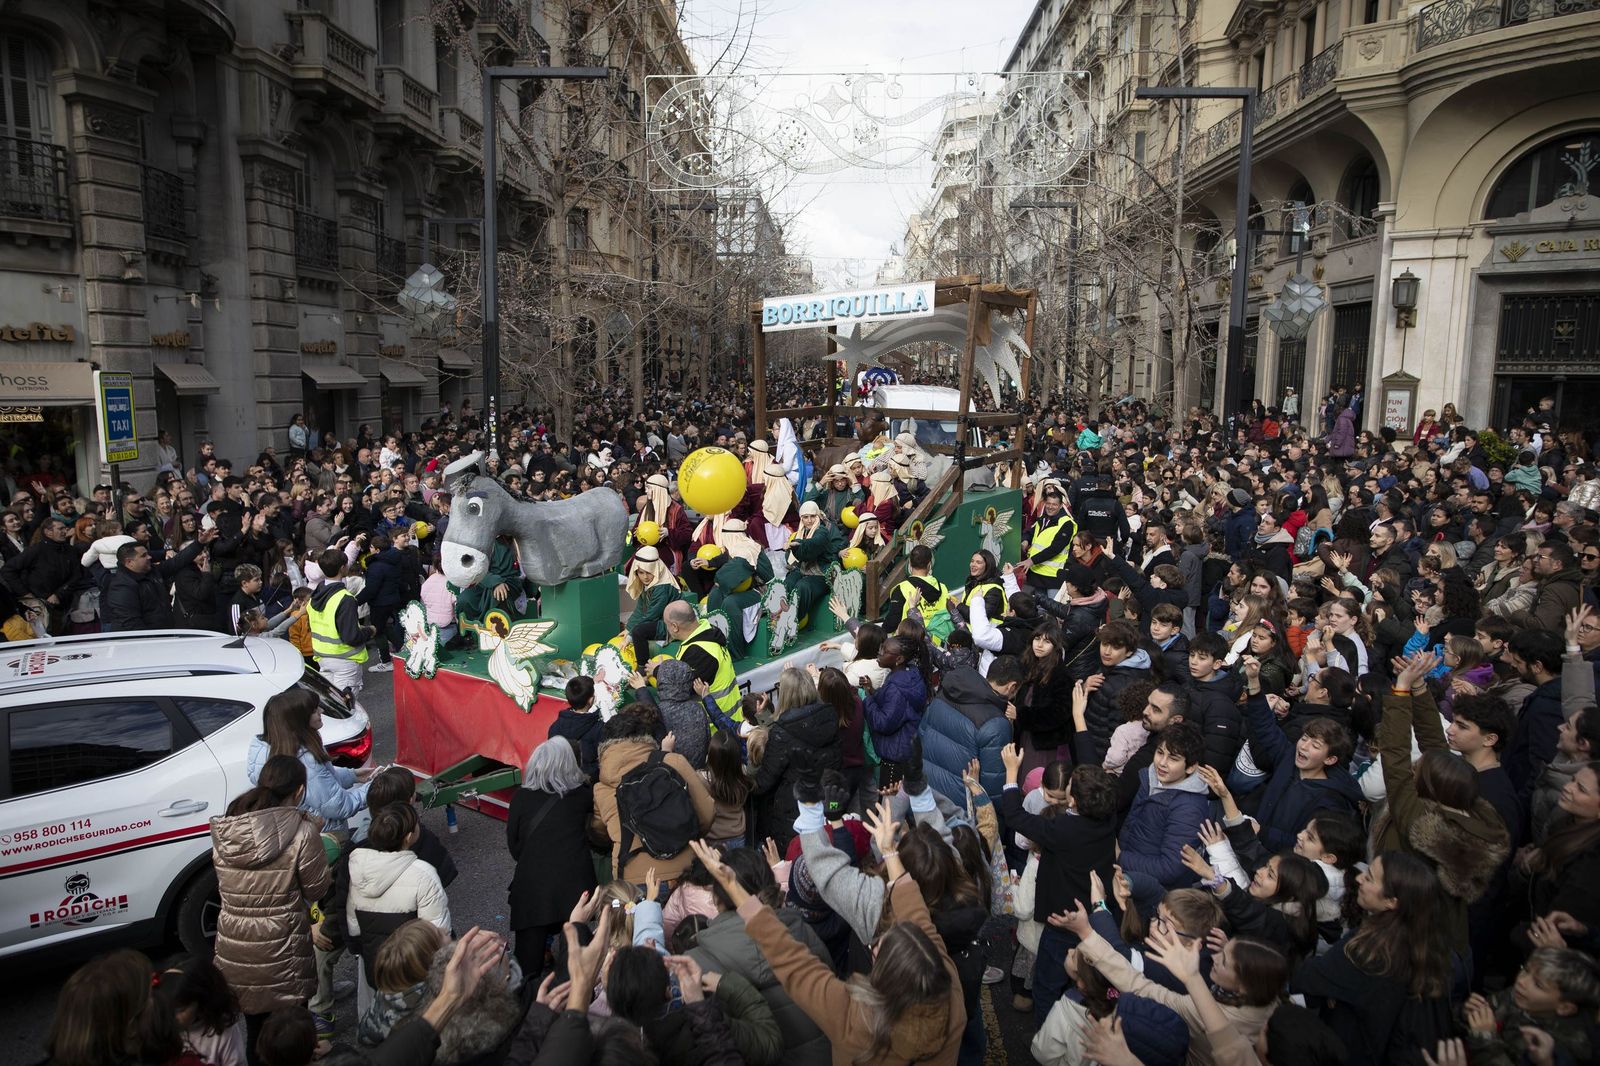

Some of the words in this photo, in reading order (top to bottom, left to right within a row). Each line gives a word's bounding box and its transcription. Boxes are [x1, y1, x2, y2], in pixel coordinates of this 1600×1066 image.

[1536, 239, 1578, 253] CAJA
[763, 289, 928, 326] BORRIQUILLA
[0, 322, 75, 343] tefiel
[0, 373, 49, 386] hoss
[112, 419, 130, 432] TAXI
[1, 820, 152, 857] WWW.RODICHSEGURIDAD.COM
[13, 829, 39, 843] 958
[42, 824, 66, 837] 800
[71, 818, 92, 831] 114
